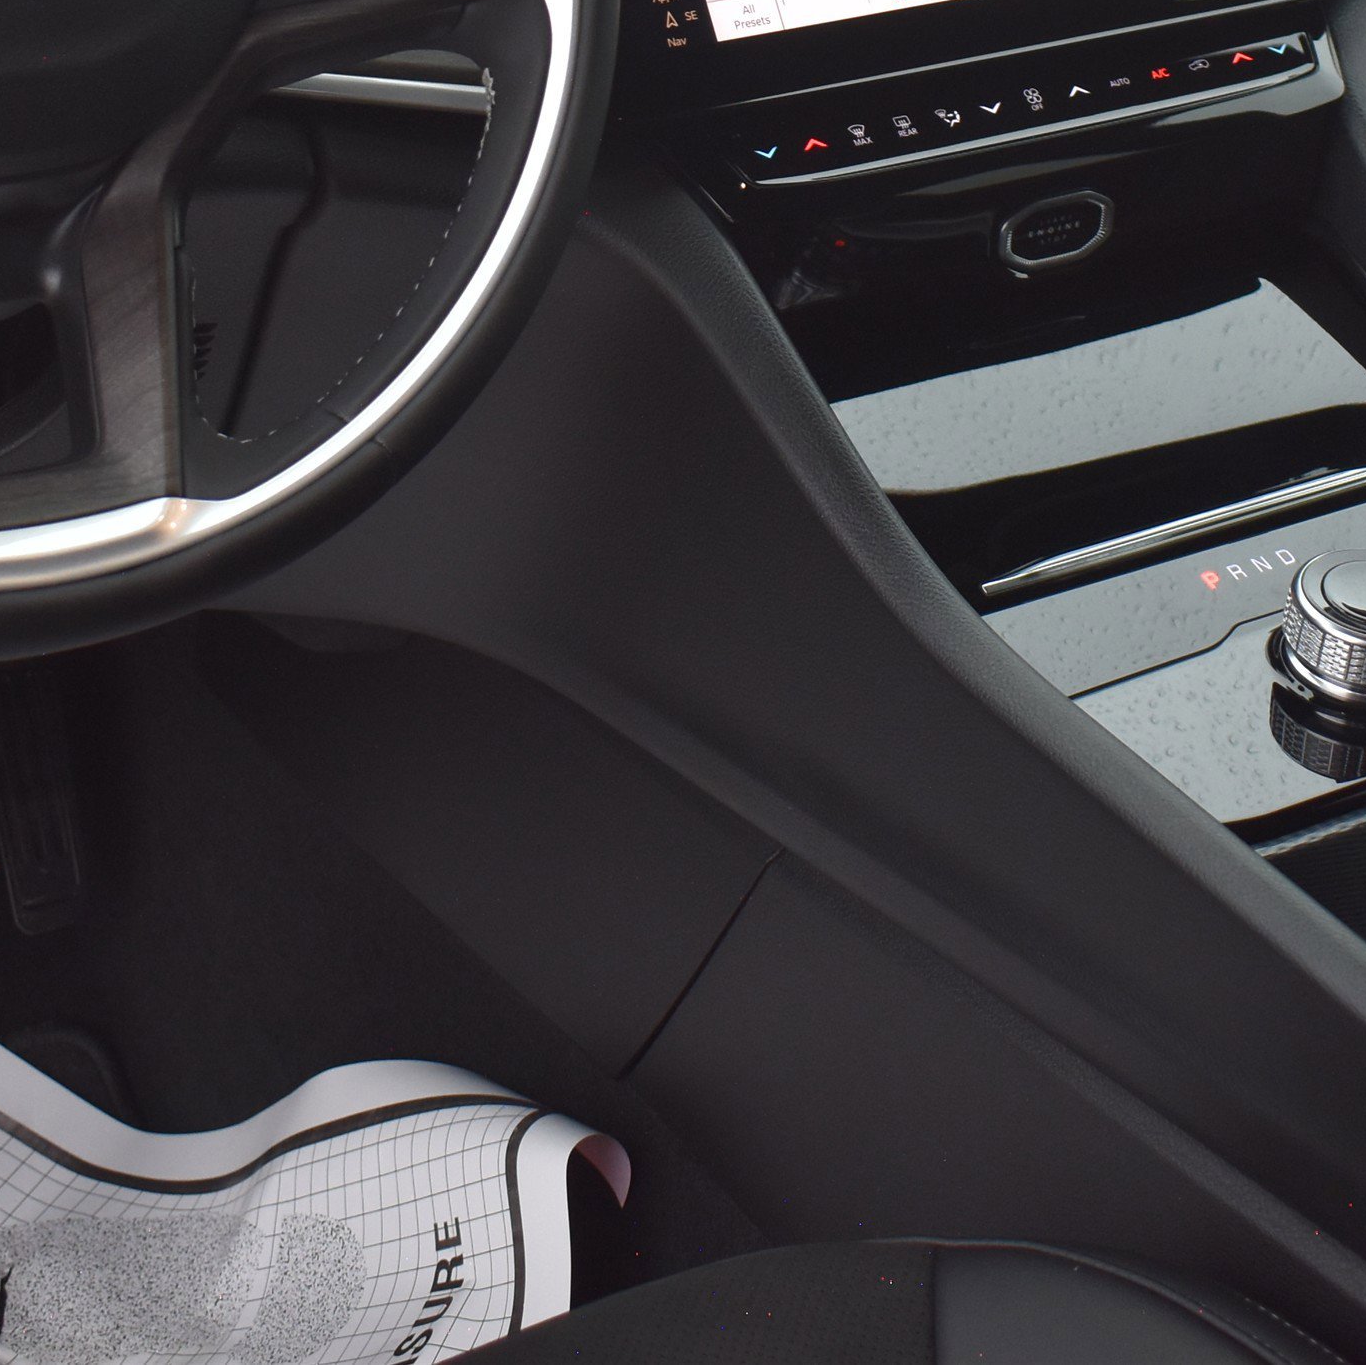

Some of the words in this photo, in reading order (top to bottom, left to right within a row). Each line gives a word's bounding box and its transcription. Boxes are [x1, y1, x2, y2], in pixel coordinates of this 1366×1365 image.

[743, 4, 755, 15] All
[685, 10, 698, 21] SE
[734, 16, 771, 30] Presets
[667, 37, 687, 47] Nav
[1151, 67, 1171, 80] A/C
[1110, 77, 1130, 88] AUTO
[1031, 102, 1044, 112] OFF
[898, 127, 918, 137] REAR
[853, 136, 873, 147] MAX
[1200, 570, 1221, 591] P
[1226, 563, 1248, 580] R
[1250, 555, 1273, 573] N
[1275, 549, 1295, 565] D
[392, 1216, 464, 1365] SURE
